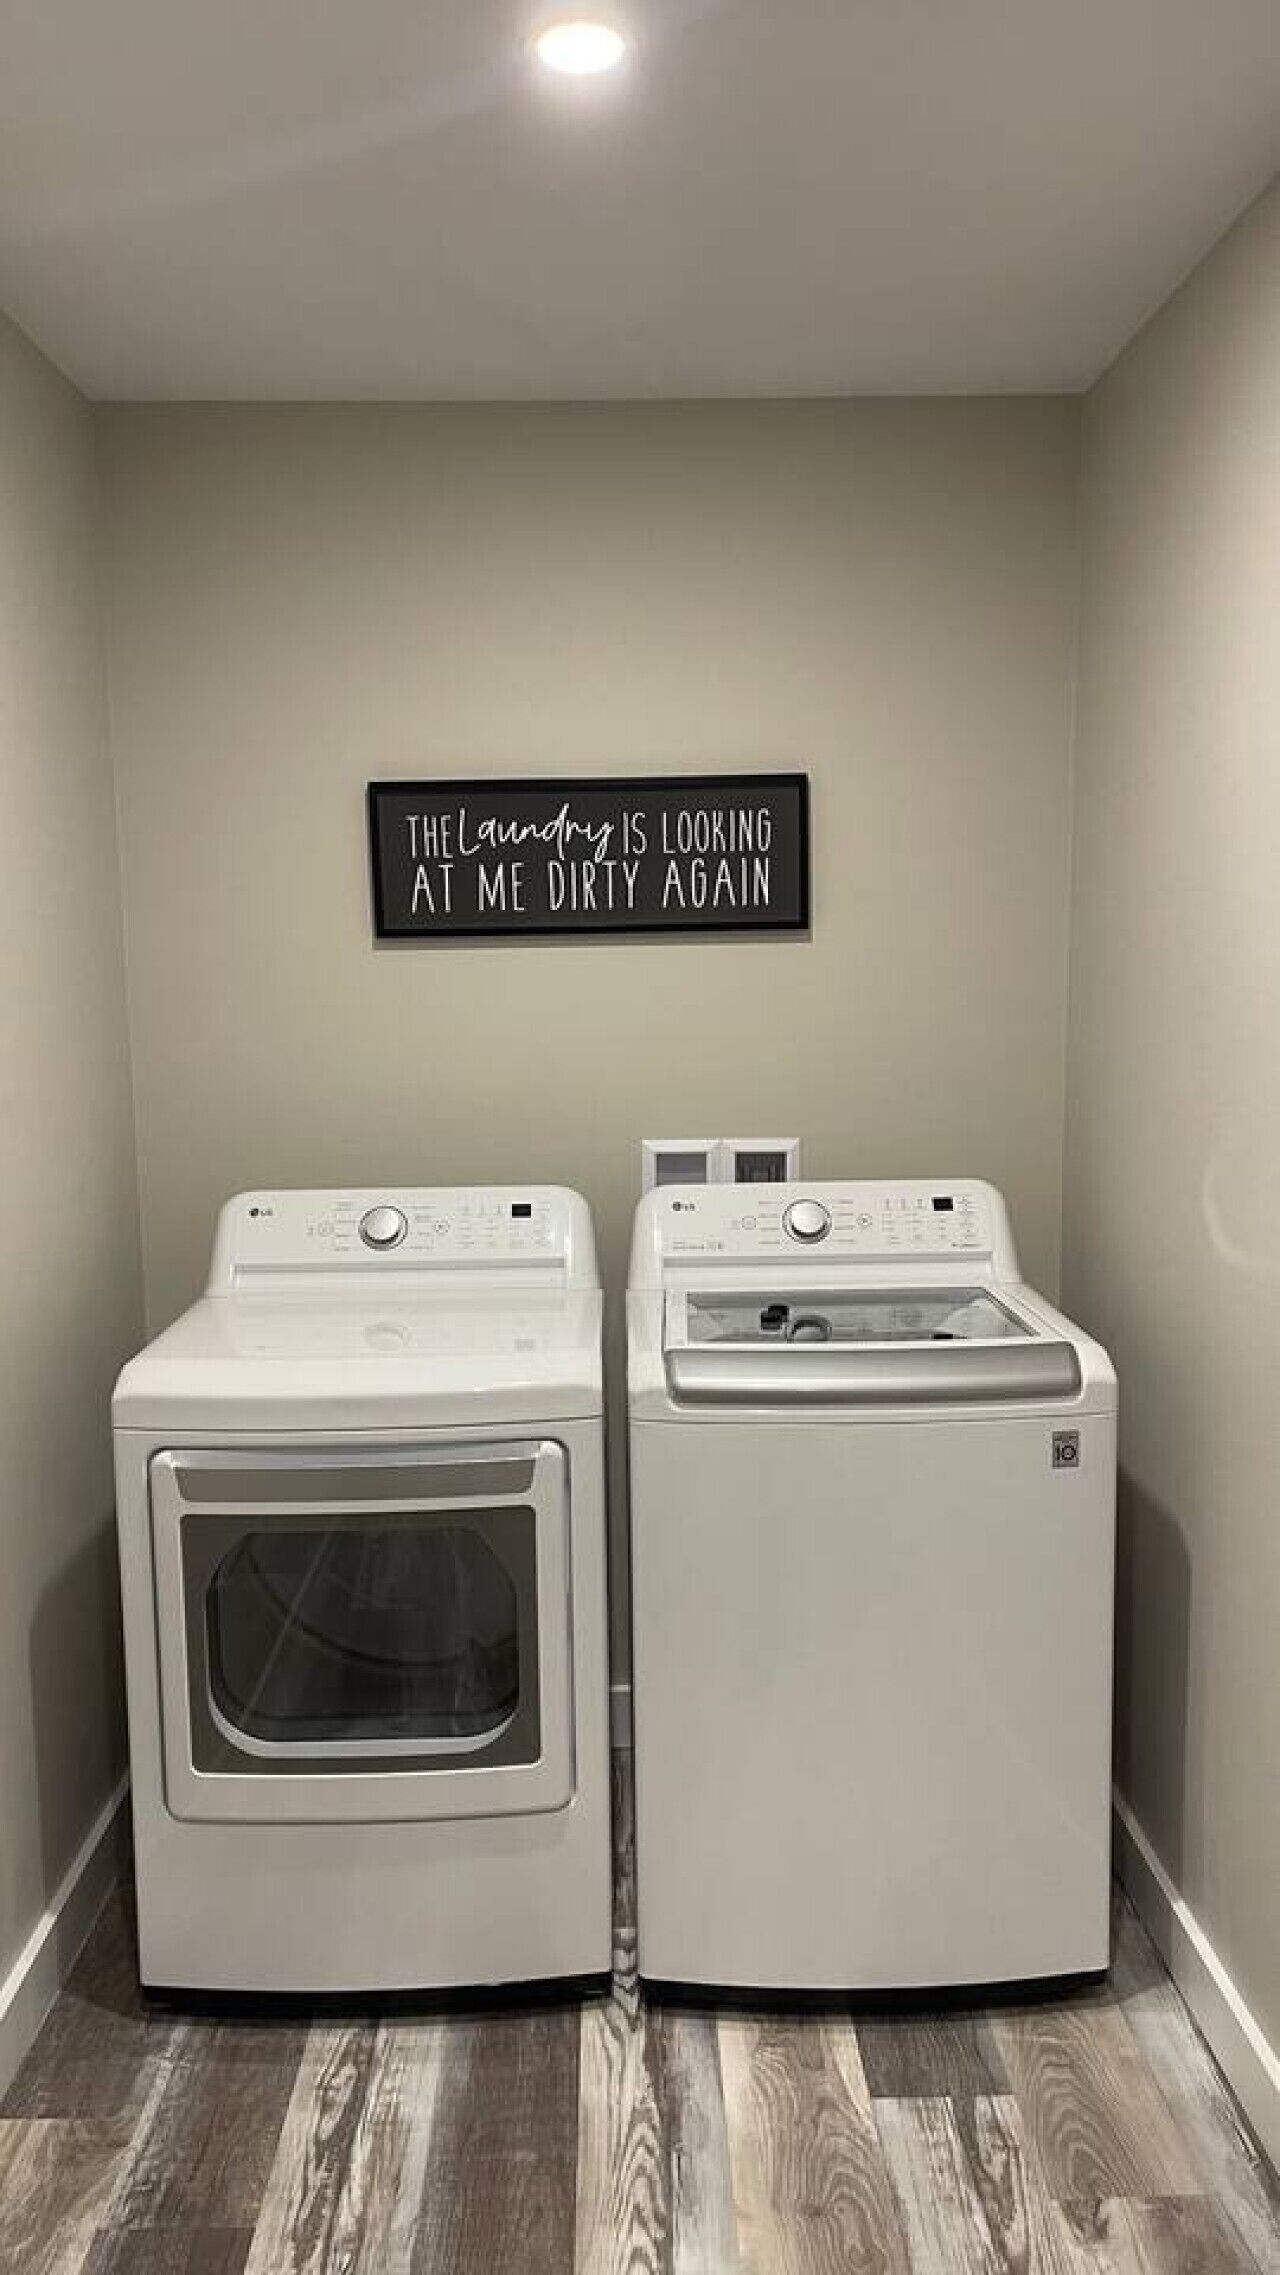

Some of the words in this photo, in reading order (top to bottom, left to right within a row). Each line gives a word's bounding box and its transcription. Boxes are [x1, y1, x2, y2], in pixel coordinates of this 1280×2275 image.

[406, 814, 454, 859] THE
[459, 803, 615, 864] Laundry
[622, 812, 649, 855] IS
[662, 809, 771, 854] LOOKING
[411, 863, 454, 914] AT
[478, 862, 526, 911] ME
[547, 859, 640, 911] DIRTY
[662, 857, 770, 909] AGAIN
